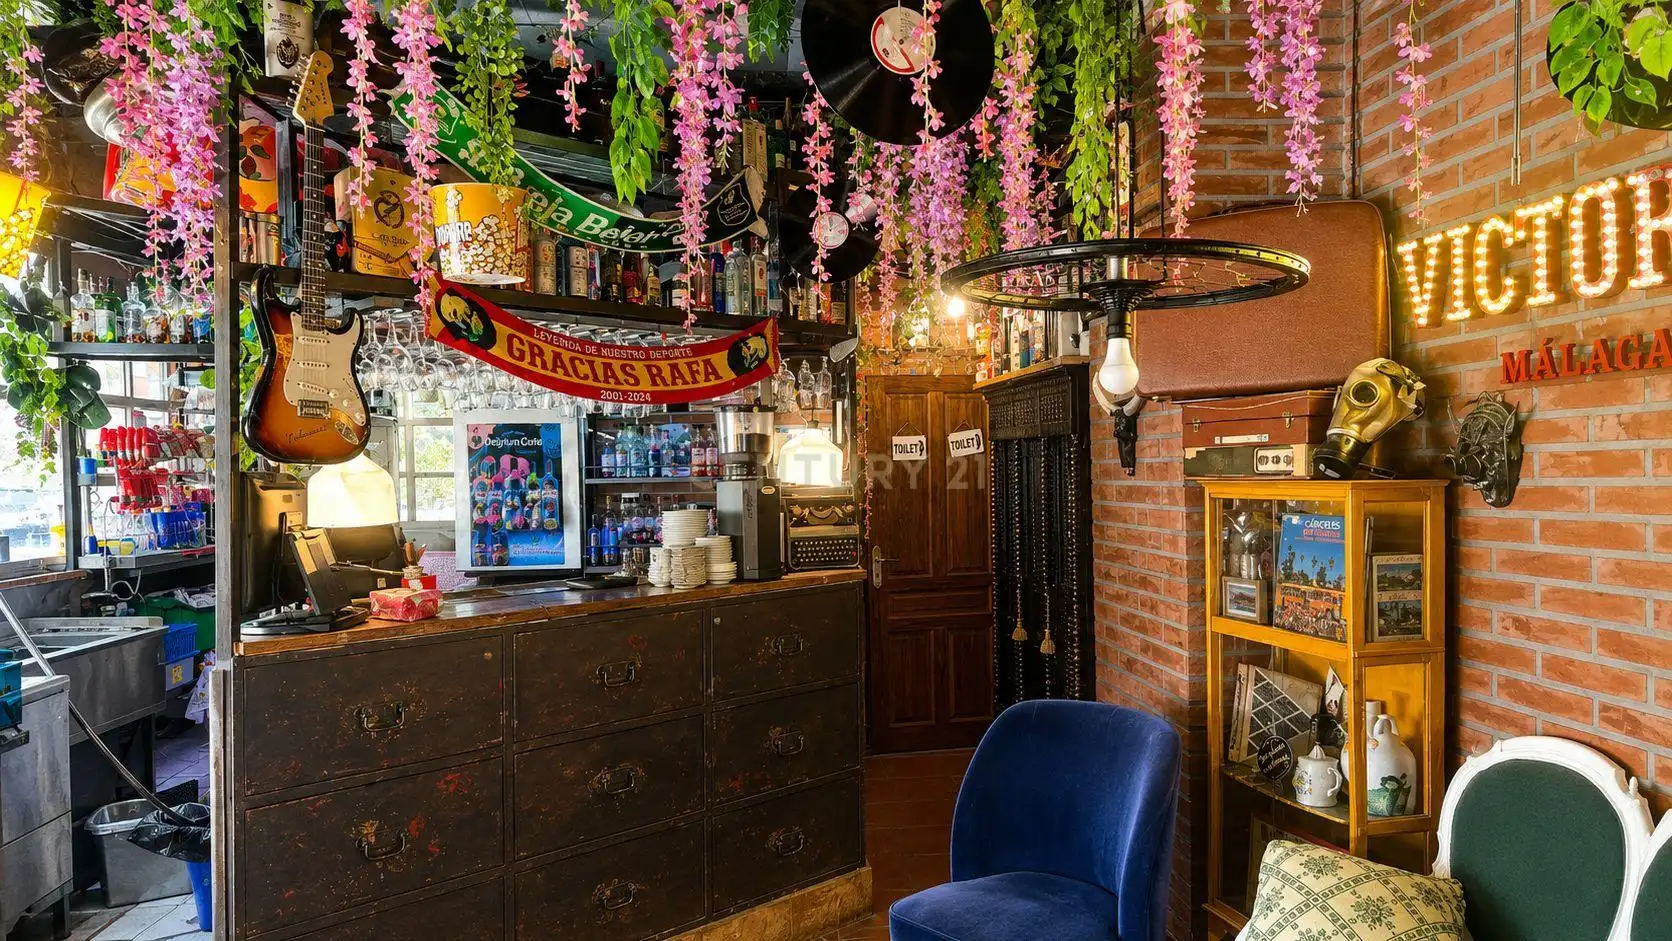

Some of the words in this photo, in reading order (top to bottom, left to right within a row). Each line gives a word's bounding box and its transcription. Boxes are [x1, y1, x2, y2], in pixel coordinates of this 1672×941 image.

[533, 327, 581, 352] LEYENDA
[585, 345, 598, 355] DE
[601, 347, 646, 359] NUESTRO
[649, 347, 693, 359] DEPORTE
[506, 332, 641, 387] GRACIAS
[643, 358, 723, 387] RAFA
[1500, 328, 1672, 385] MÁLAGA
[600, 389, 651, 401] 2001-2024
[893, 443, 919, 455] TOILET
[950, 437, 975, 451] TOILET
